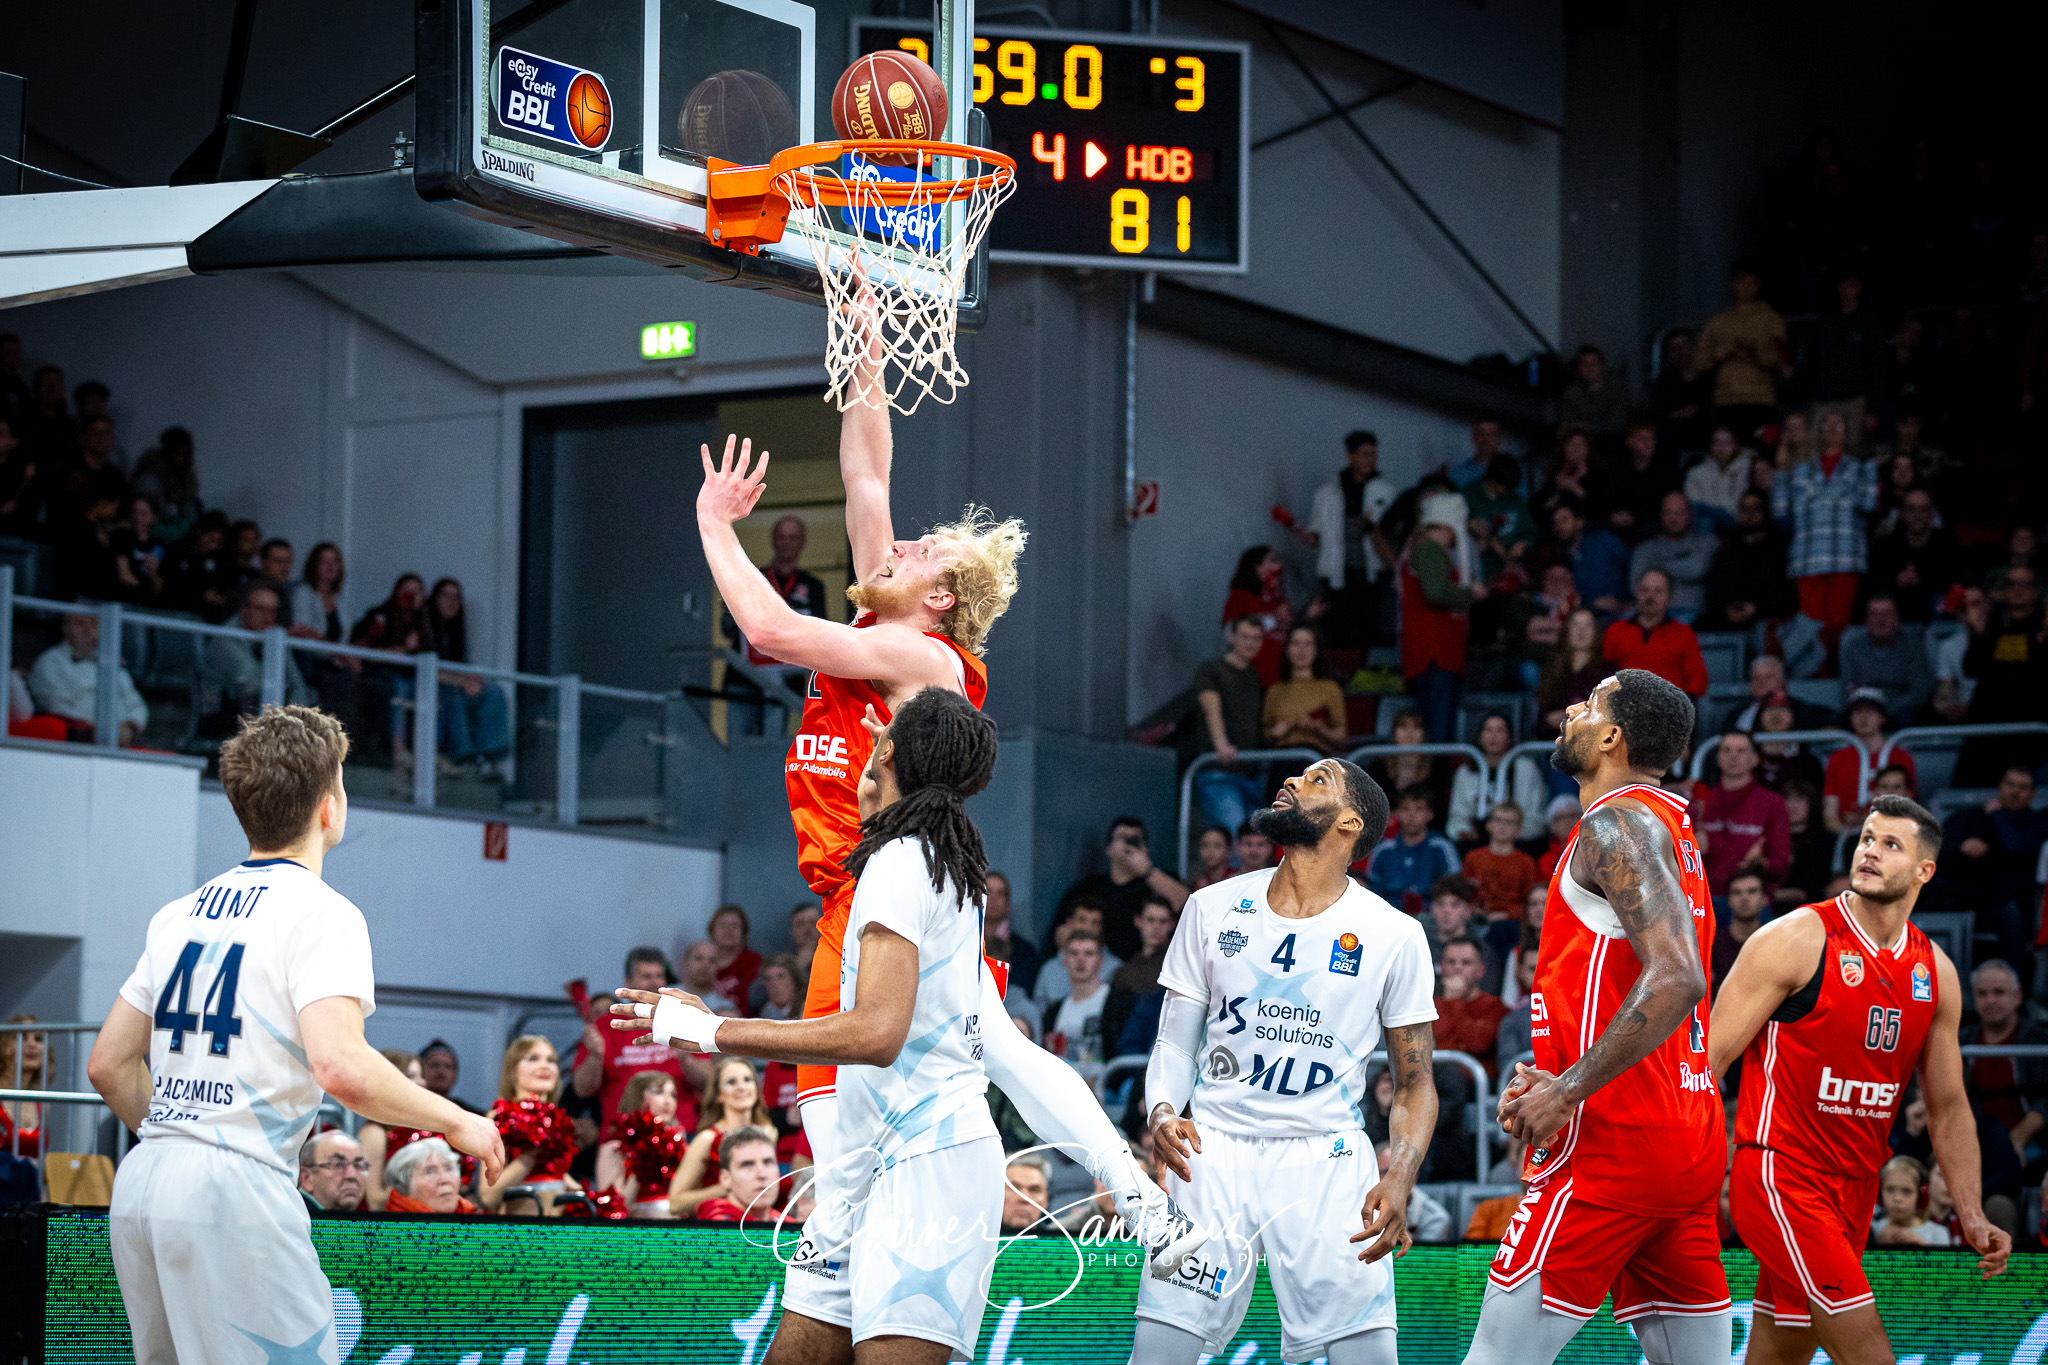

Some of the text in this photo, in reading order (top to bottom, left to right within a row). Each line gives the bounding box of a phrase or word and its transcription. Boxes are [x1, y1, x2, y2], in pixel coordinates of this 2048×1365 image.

[522, 75, 556, 99] Credit
[507, 90, 555, 131] BBL
[910, 108, 924, 134] BBL
[482, 150, 535, 182] SPALDING
[1110, 187, 1192, 254] 81
[189, 886, 269, 920] HUNT
[1271, 933, 1297, 973] 4
[1332, 961, 1356, 973] BBL
[154, 938, 247, 1059] 44
[1255, 1024, 1334, 1049] solutions
[1865, 1005, 1902, 1052] 65
[1239, 1053, 1334, 1096] MLP
[1817, 1101, 1854, 1116] Technik
[808, 1265, 837, 1281] Gesellschaft
[1178, 1279, 1196, 1292] bester
